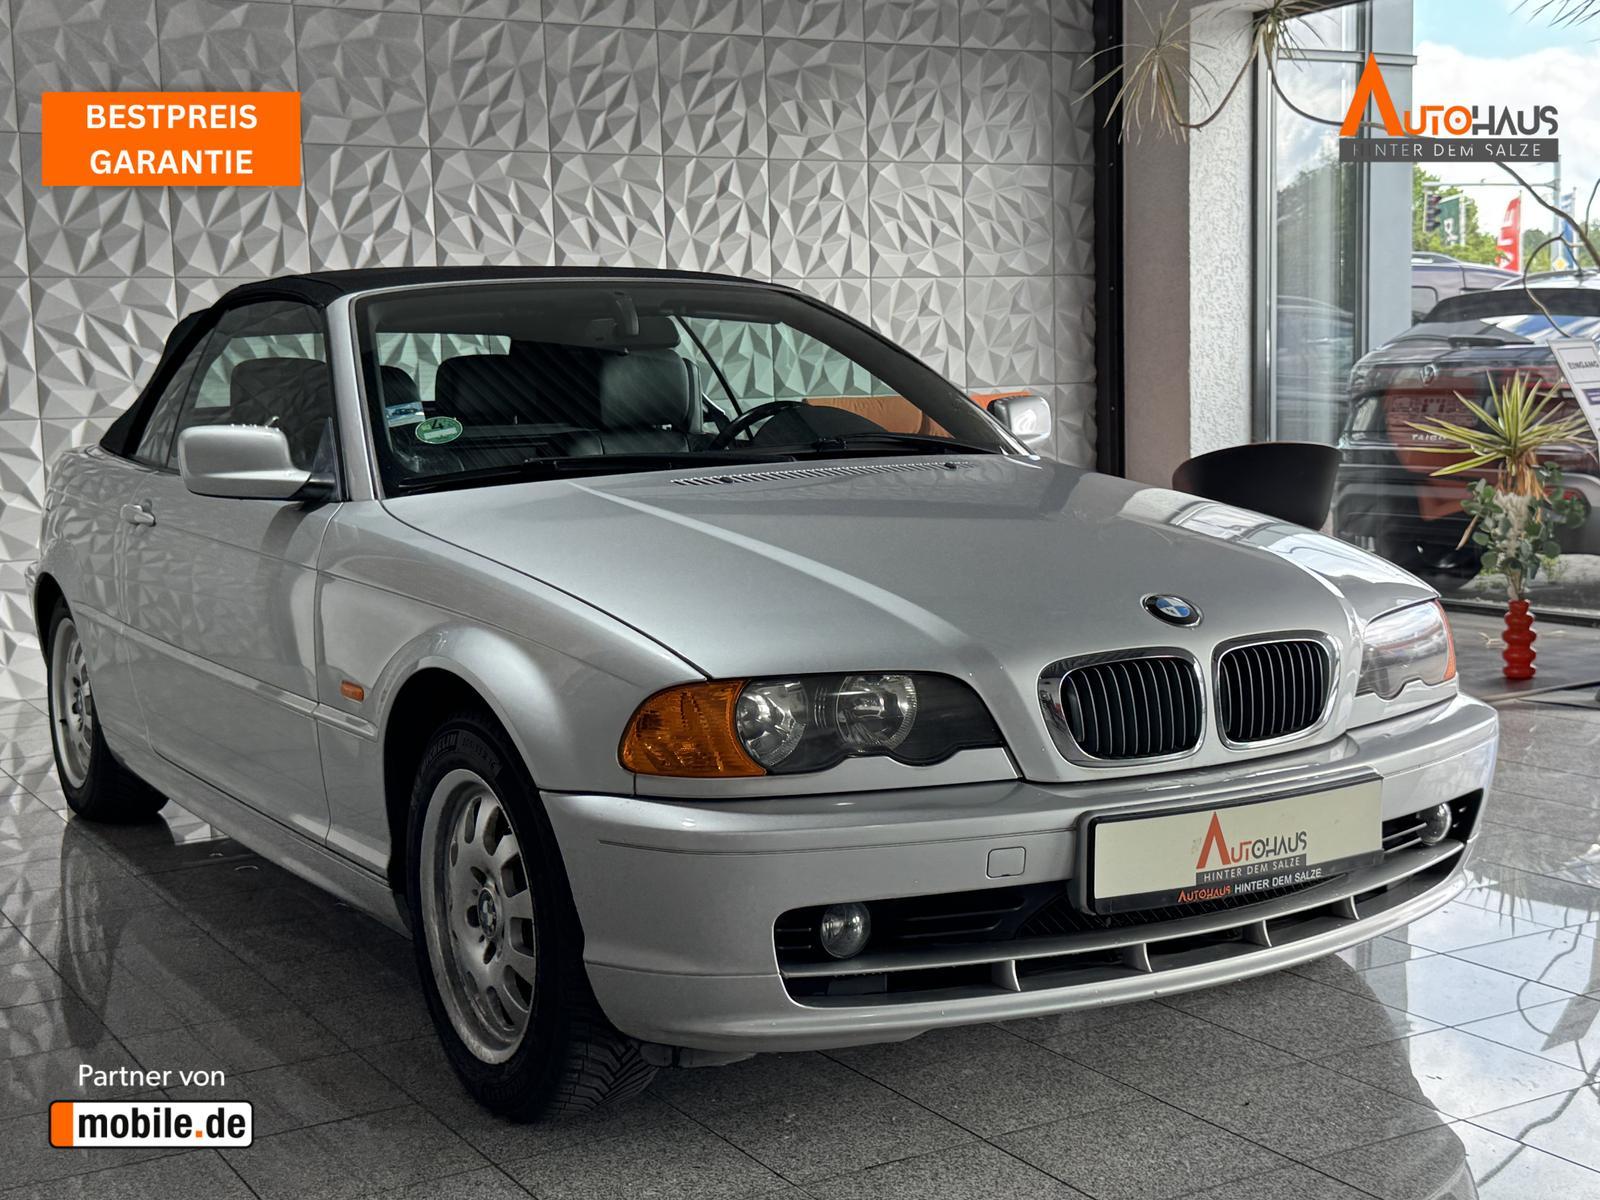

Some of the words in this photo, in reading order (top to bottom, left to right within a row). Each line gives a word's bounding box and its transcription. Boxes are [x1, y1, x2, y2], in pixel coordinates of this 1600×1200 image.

[1196, 811, 1307, 869] AUTOHAUS
[1178, 885, 1233, 903] AUTOHAUS
[1234, 878, 1270, 894] HINTER
[1272, 874, 1292, 887] DEM
[1294, 867, 1322, 882] SALZE
[1203, 869, 1242, 883] HINTER
[1246, 862, 1269, 875] DEM
[1272, 856, 1300, 871] SALZE
